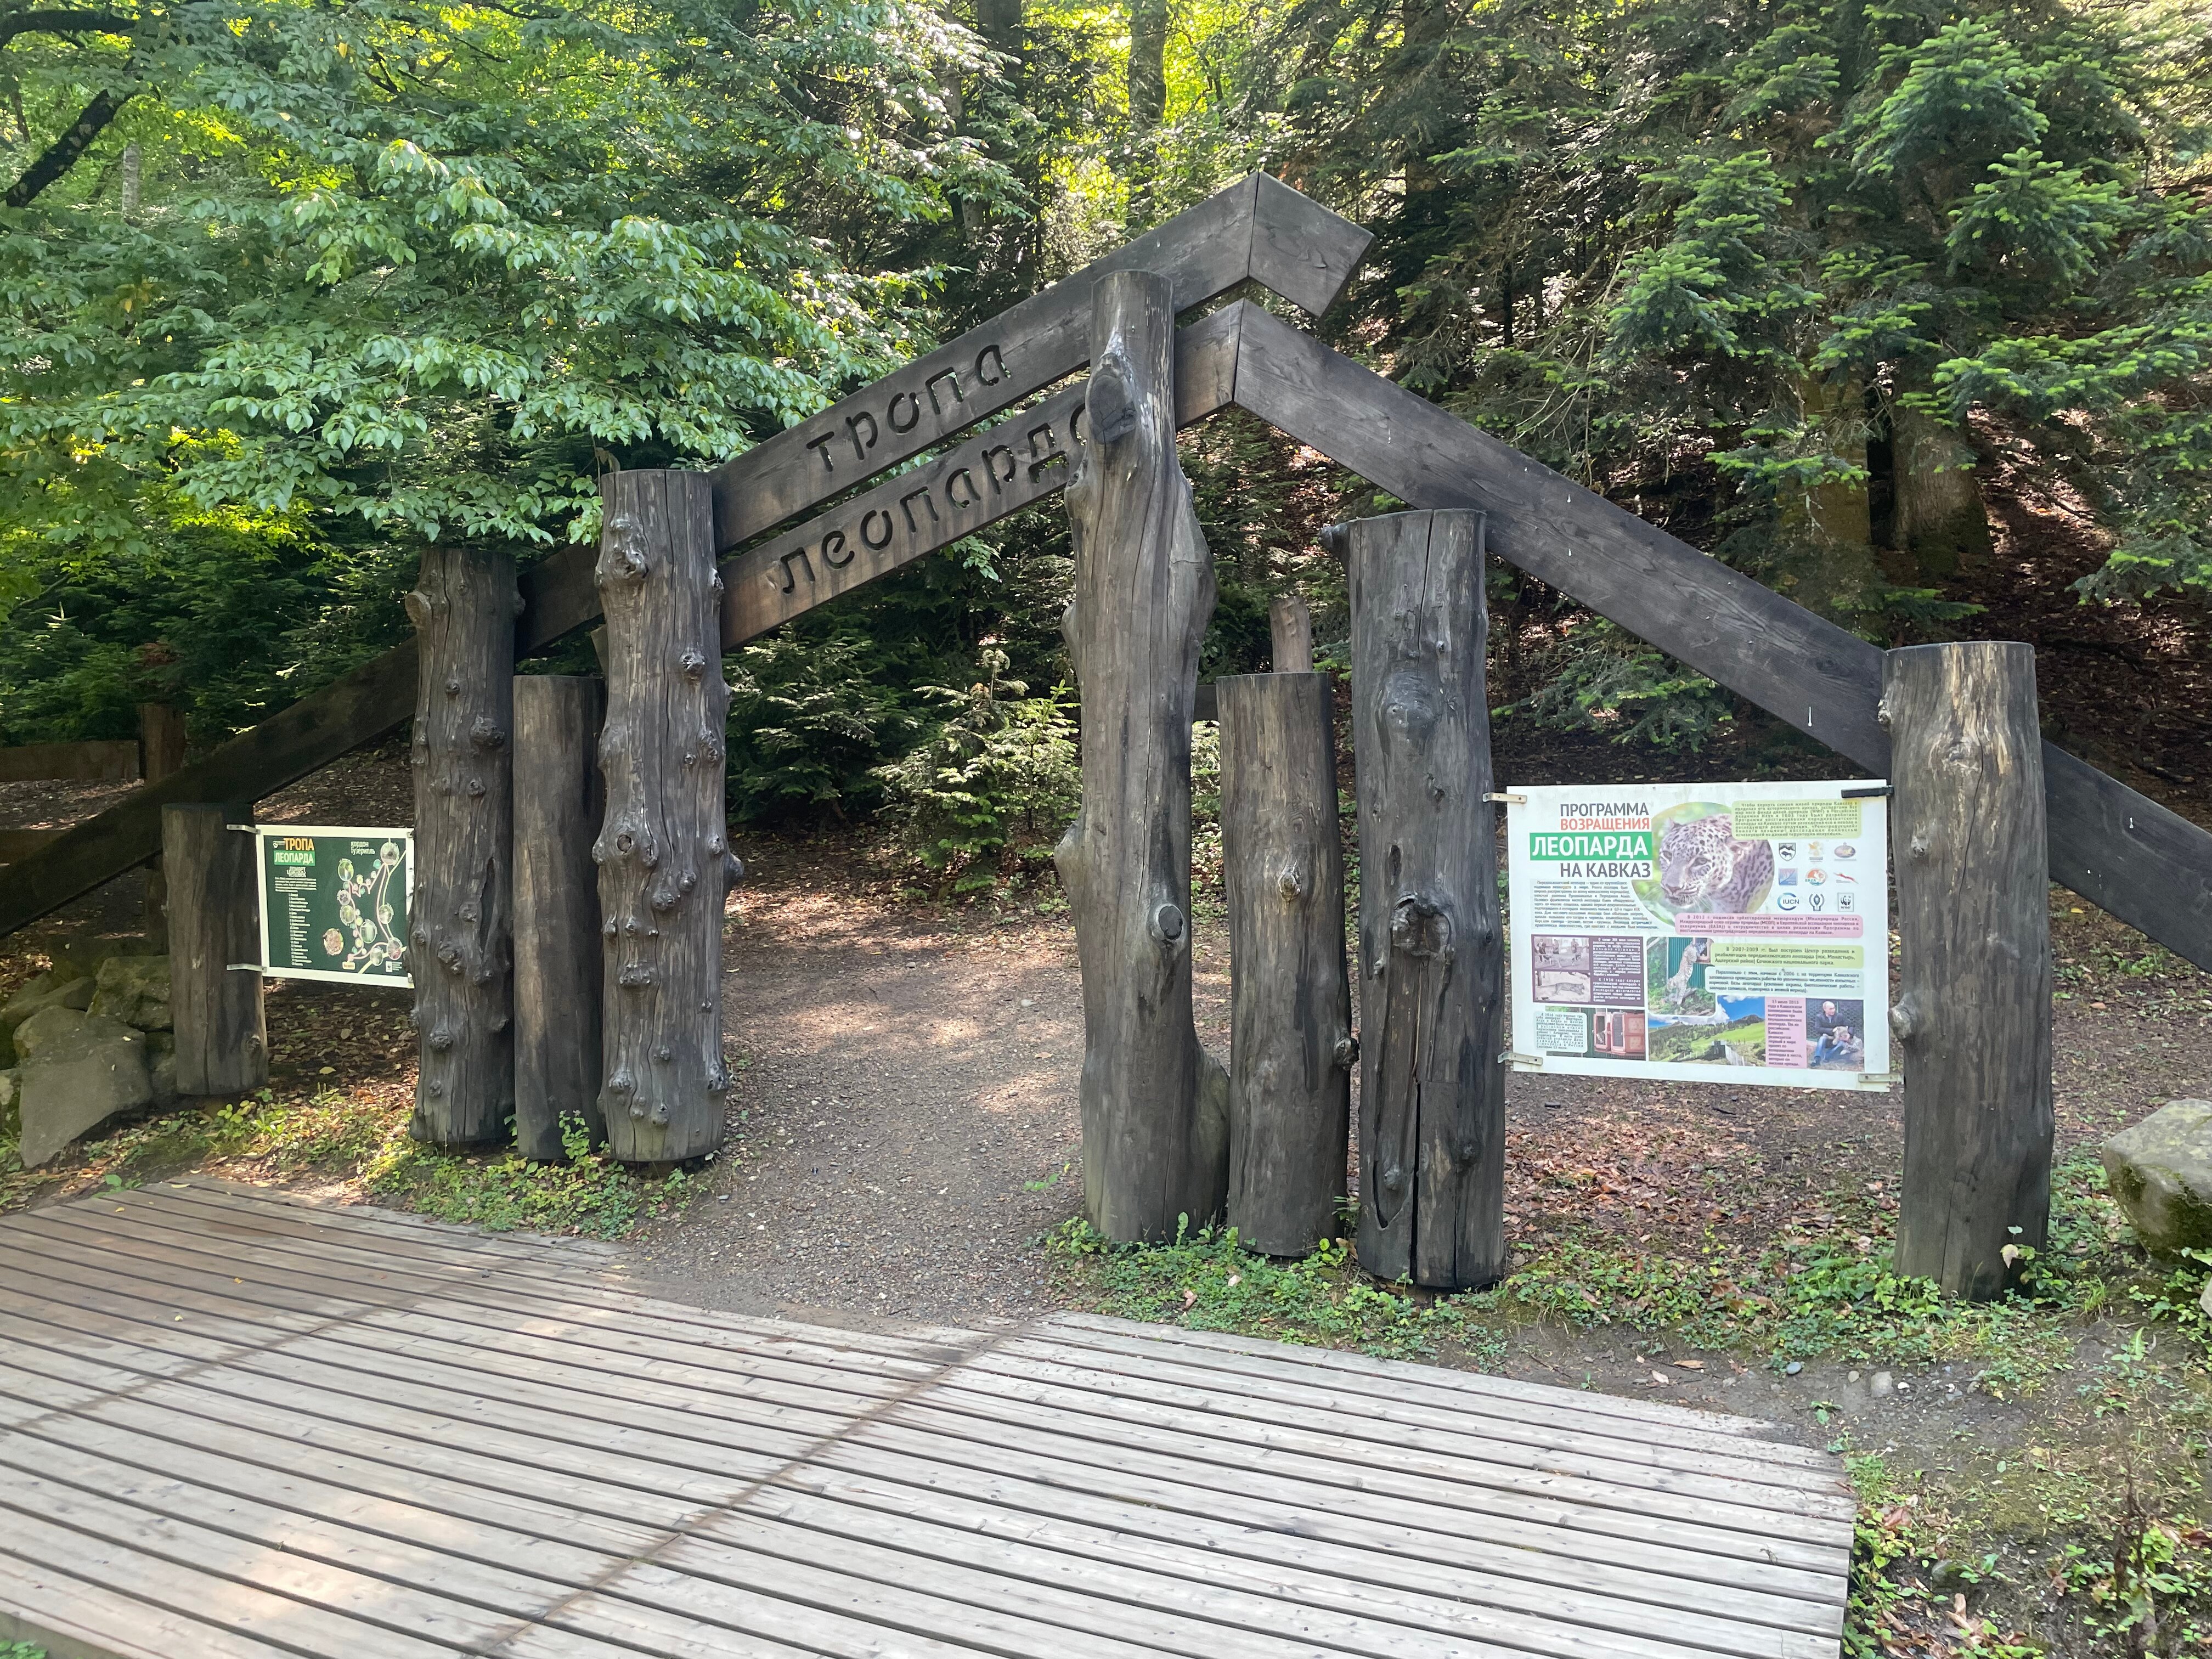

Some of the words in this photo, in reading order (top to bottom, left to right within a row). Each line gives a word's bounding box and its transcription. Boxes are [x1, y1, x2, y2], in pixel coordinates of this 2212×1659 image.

[1561, 803, 1649, 817] ПРОГРАММА
[1561, 817, 1650, 832] ВОЗРАЩЕНИЯ
[284, 838, 314, 851] ТРОПА
[1532, 836, 1648, 859] ЛЕОПАРДА
[275, 852, 314, 865] ЛЕОПАРДА
[1561, 863, 1582, 878] НА
[1587, 863, 1651, 878] КАВКАЗ
